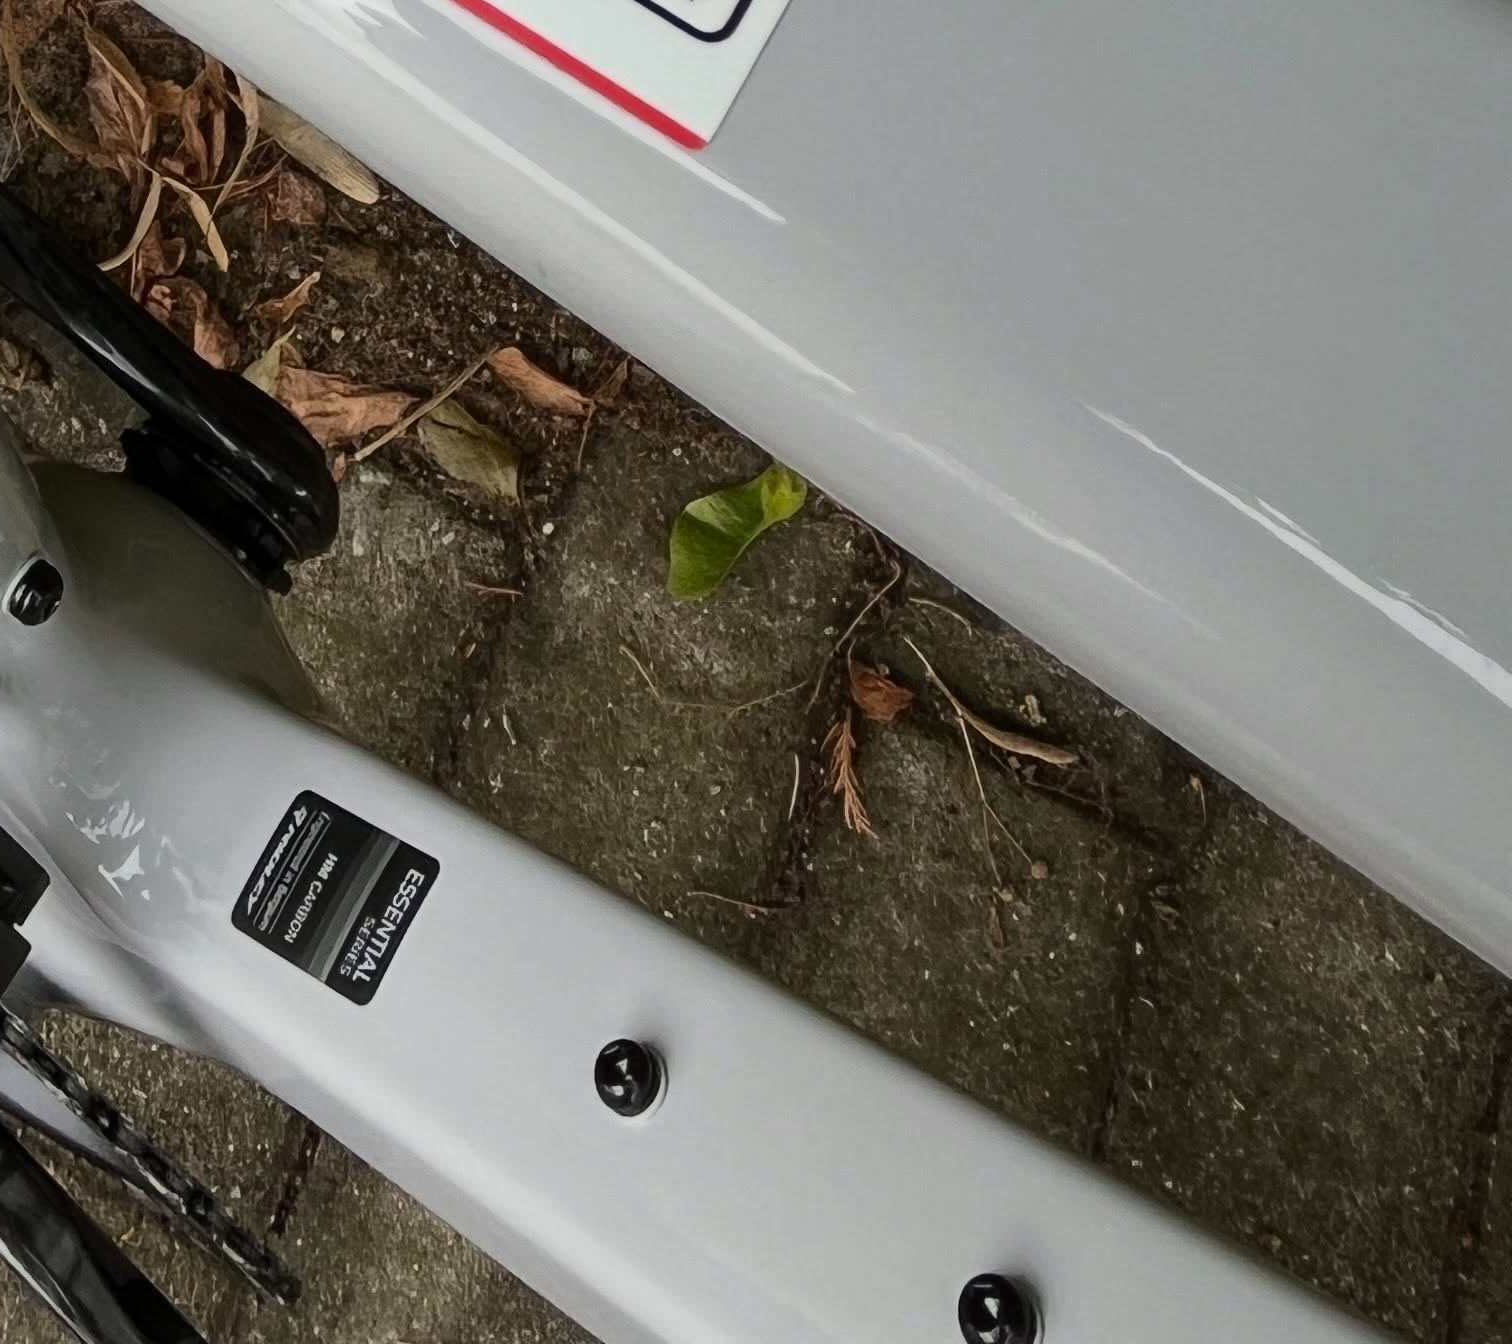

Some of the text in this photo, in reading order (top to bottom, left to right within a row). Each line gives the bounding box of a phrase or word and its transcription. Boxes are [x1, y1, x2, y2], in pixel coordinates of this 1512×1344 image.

[284, 881, 324, 945] CARBON
[350, 868, 425, 983] ESSENTIAL
[340, 916, 376, 977] SERIES
